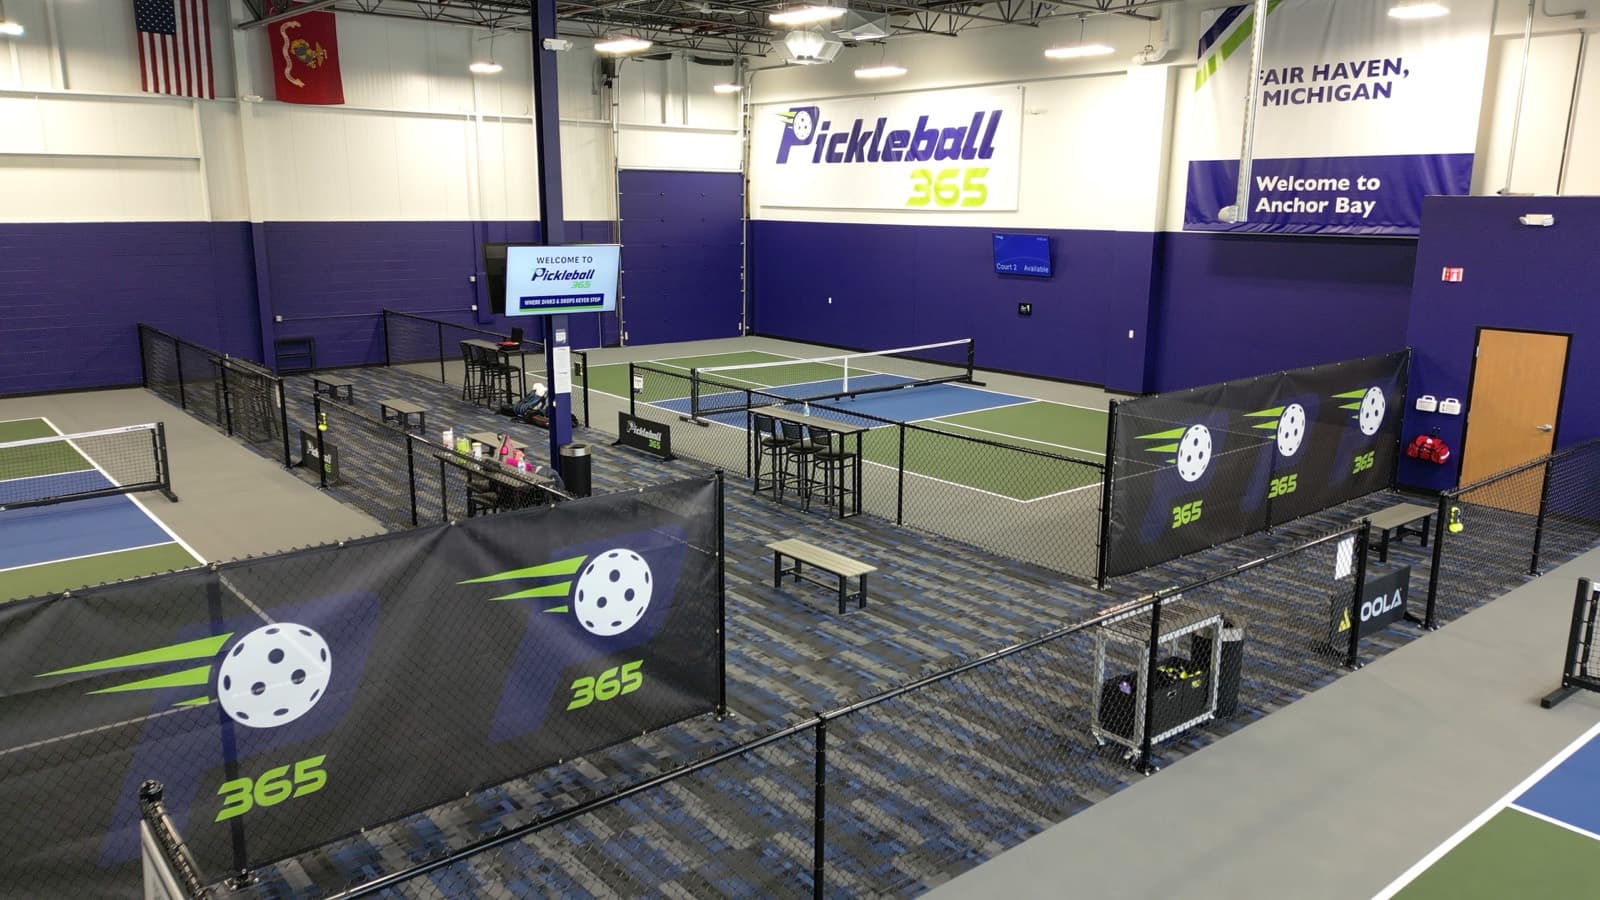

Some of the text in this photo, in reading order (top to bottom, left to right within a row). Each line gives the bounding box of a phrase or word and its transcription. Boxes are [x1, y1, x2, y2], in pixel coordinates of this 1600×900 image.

[1260, 57, 1410, 86] AIR HAVEN,
[1262, 81, 1393, 107] MICHIGAN
[775, 106, 1003, 164] Pickleball
[905, 167, 990, 207] 365
[1256, 175, 1381, 192] Welcome to
[1255, 197, 1377, 218] Anchor Bay
[536, 256, 580, 264] WELCOME
[531, 267, 595, 281] Pickleball
[571, 281, 592, 289] 365
[1352, 450, 1376, 475] 365
[1267, 473, 1298, 499] 365
[1171, 499, 1204, 529] 365
[1360, 588, 1403, 622] OOLA
[566, 659, 644, 711] 365
[214, 754, 327, 823] 365
